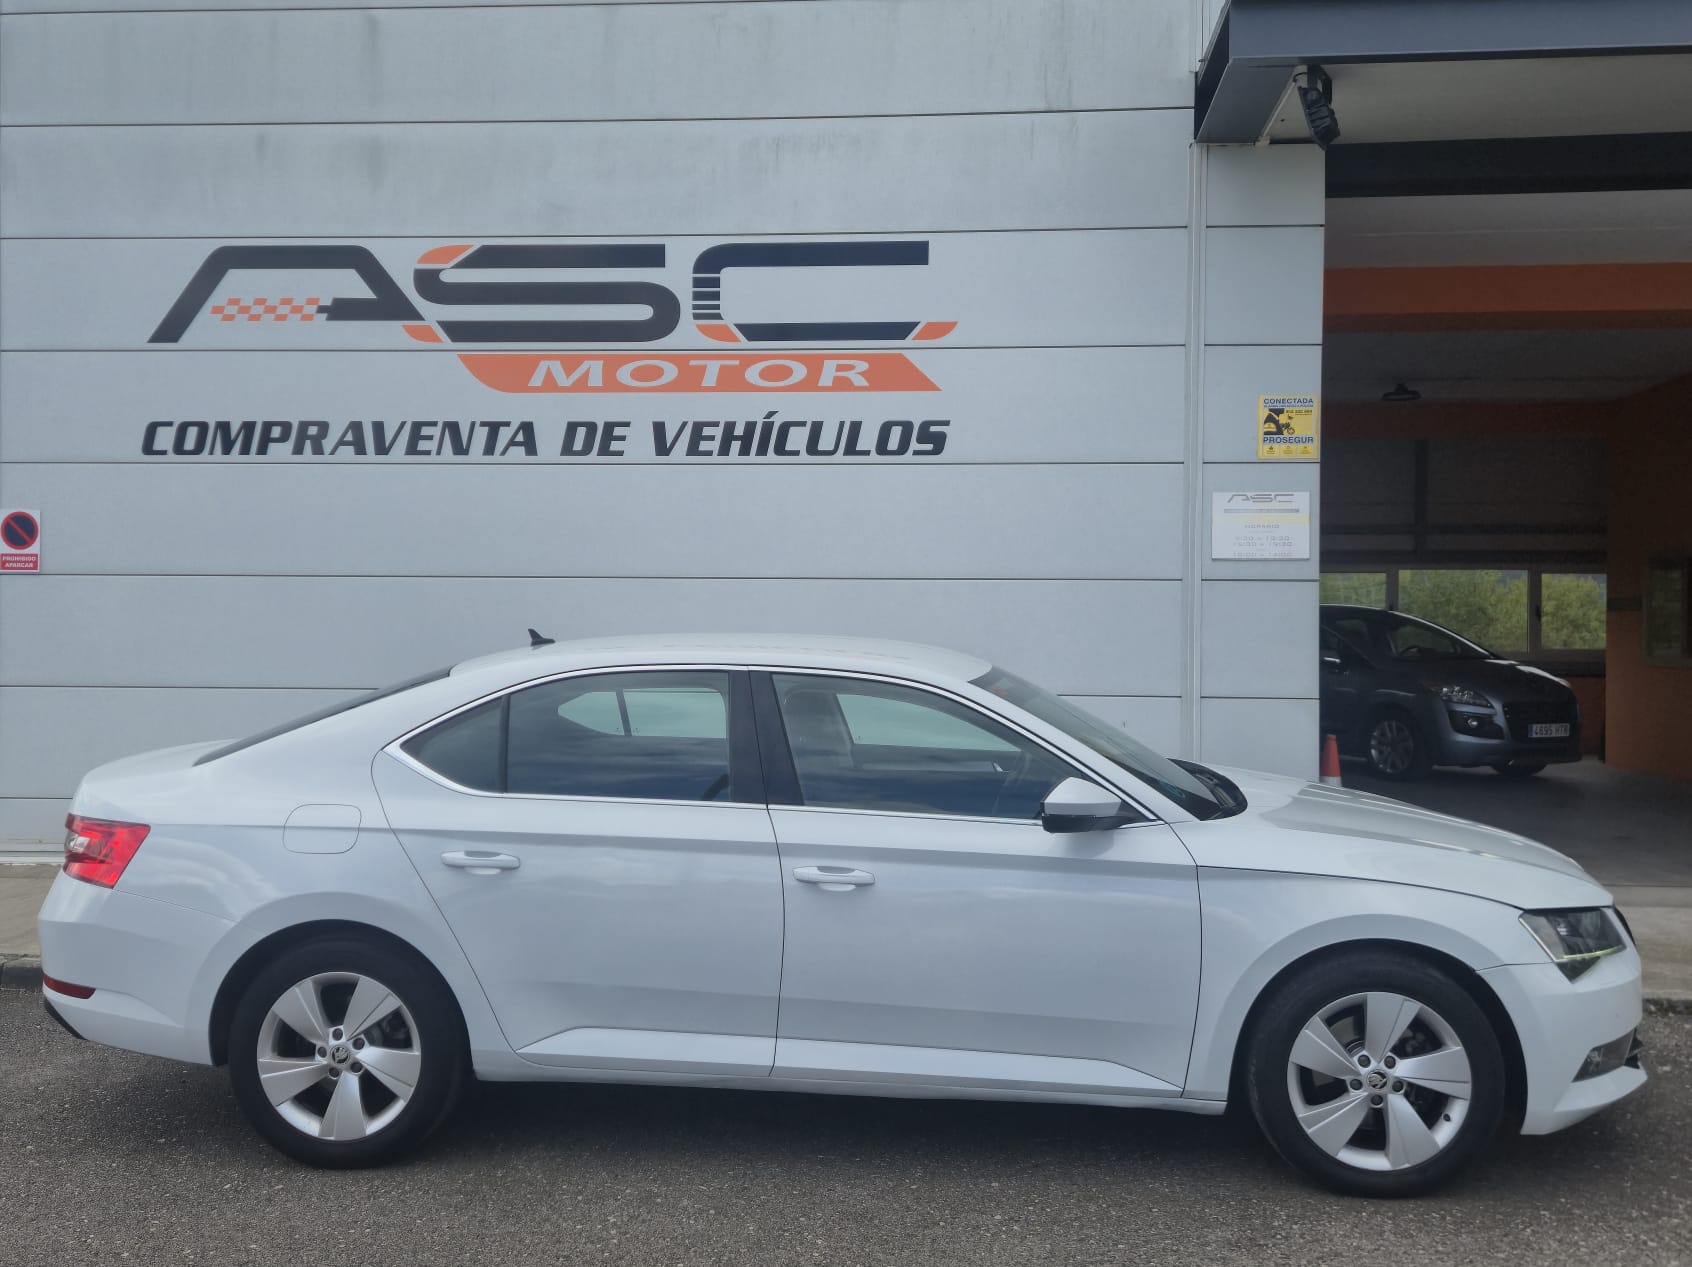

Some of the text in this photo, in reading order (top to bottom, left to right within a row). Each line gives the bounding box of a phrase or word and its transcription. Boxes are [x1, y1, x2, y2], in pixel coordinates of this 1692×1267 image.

[147, 240, 958, 345] ASC
[528, 359, 870, 388] MOTOR
[1263, 397, 1314, 405] CONECTADA
[142, 410, 951, 456] COMPRAVENTA DE VEHÍCULOS
[1263, 436, 1314, 444] PROSEGUR
[1227, 493, 1296, 503] ASC
